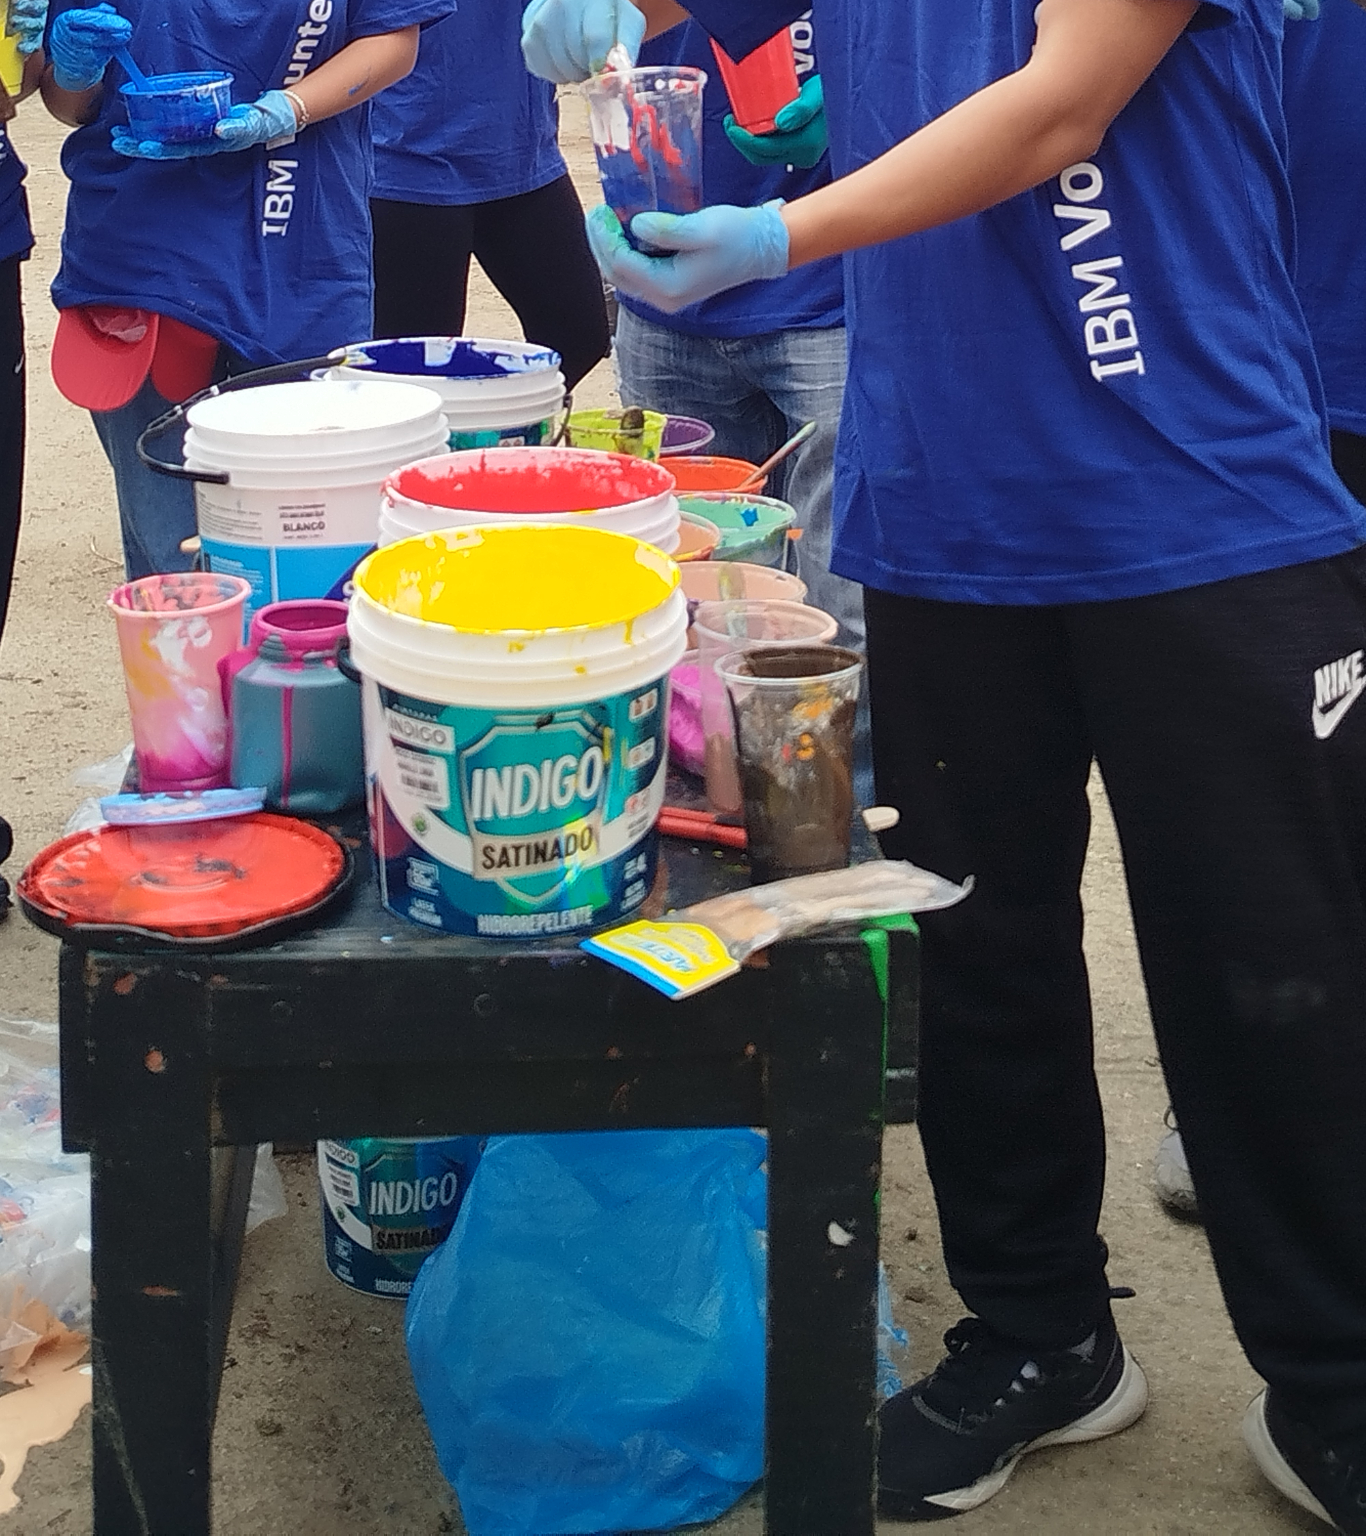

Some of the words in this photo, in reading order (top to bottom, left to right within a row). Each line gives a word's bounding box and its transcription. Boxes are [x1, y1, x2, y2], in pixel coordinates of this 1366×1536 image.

[262, 160, 298, 237] IBM
[1072, 255, 1145, 383] IBM
[283, 521, 325, 532] BLANCO
[1314, 649, 1365, 709] NIKE
[390, 718, 446, 745] INDIGO
[471, 745, 603, 821] INDIGO
[482, 824, 593, 870] SATINADO
[369, 1172, 457, 1215] INDIGO
